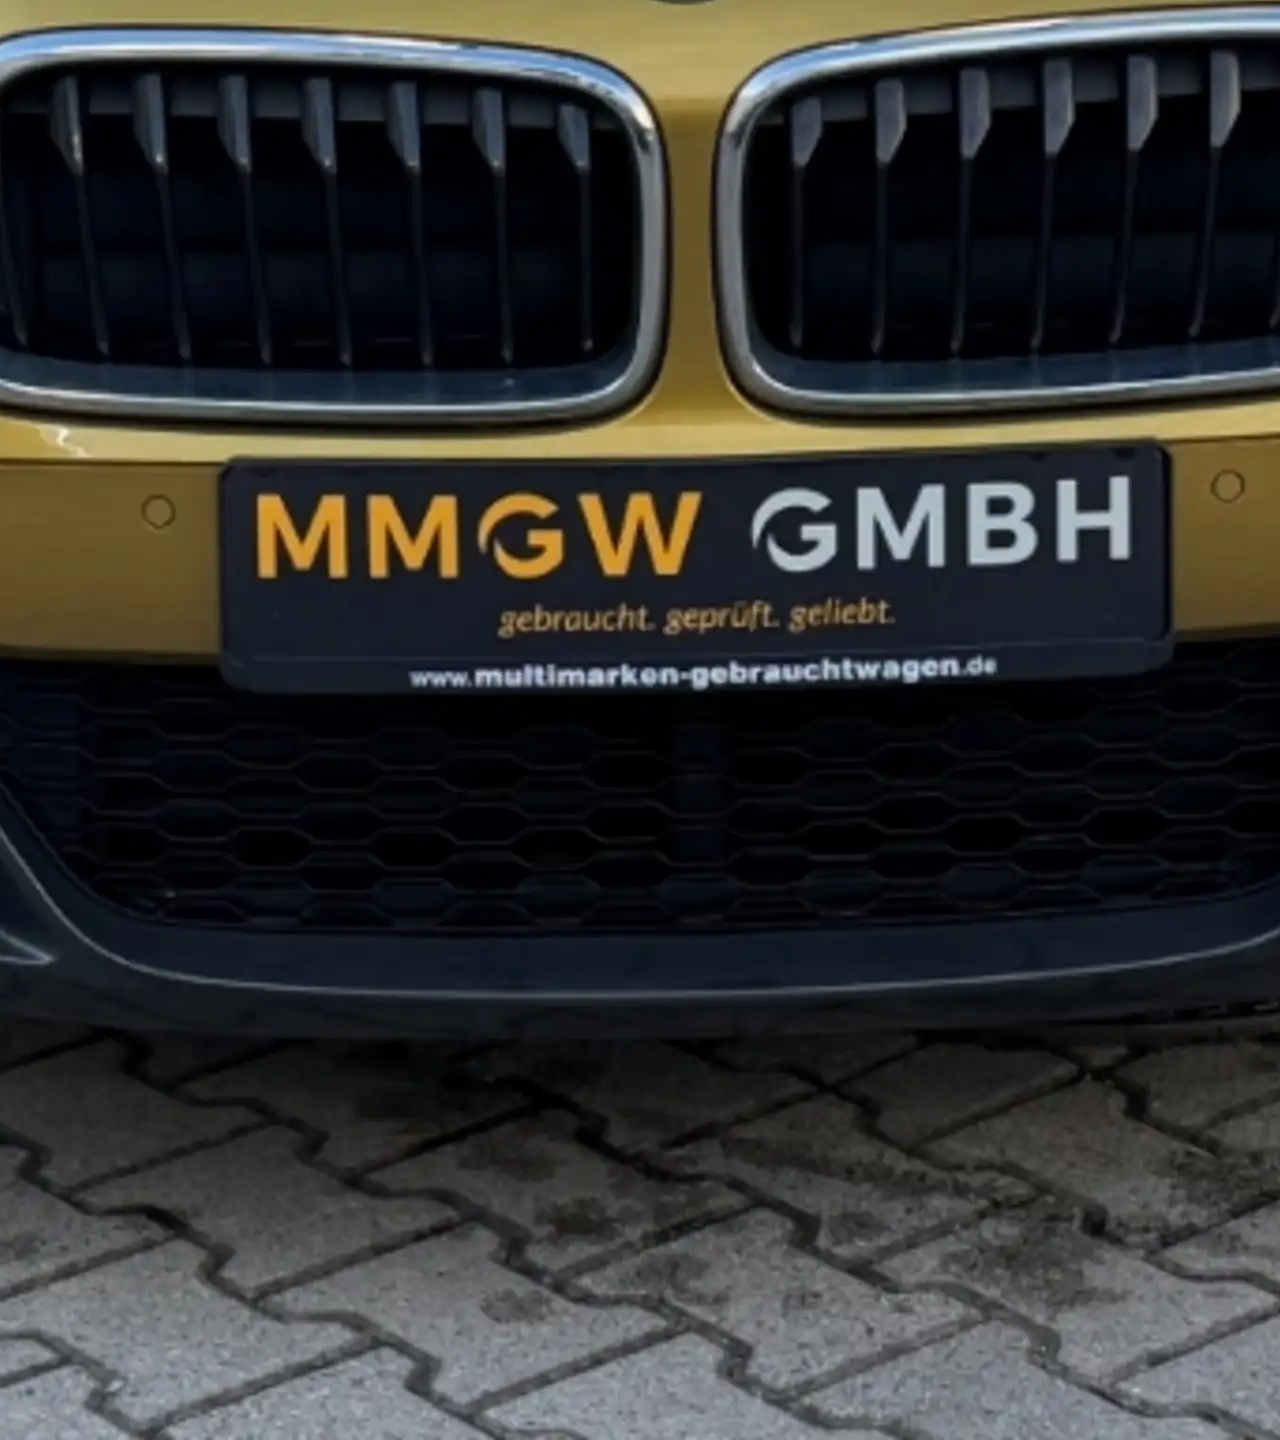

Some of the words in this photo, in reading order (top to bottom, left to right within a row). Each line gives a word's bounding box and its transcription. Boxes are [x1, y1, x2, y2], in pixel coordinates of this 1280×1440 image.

[256, 490, 704, 580] MMGW
[750, 474, 1132, 573] GMBH
[496, 603, 658, 640] gebraucht.
[661, 596, 783, 636] geprüft.
[787, 593, 898, 634] geliebt.
[408, 654, 1000, 692] www.multimarken-gebrauchtwagen.de
